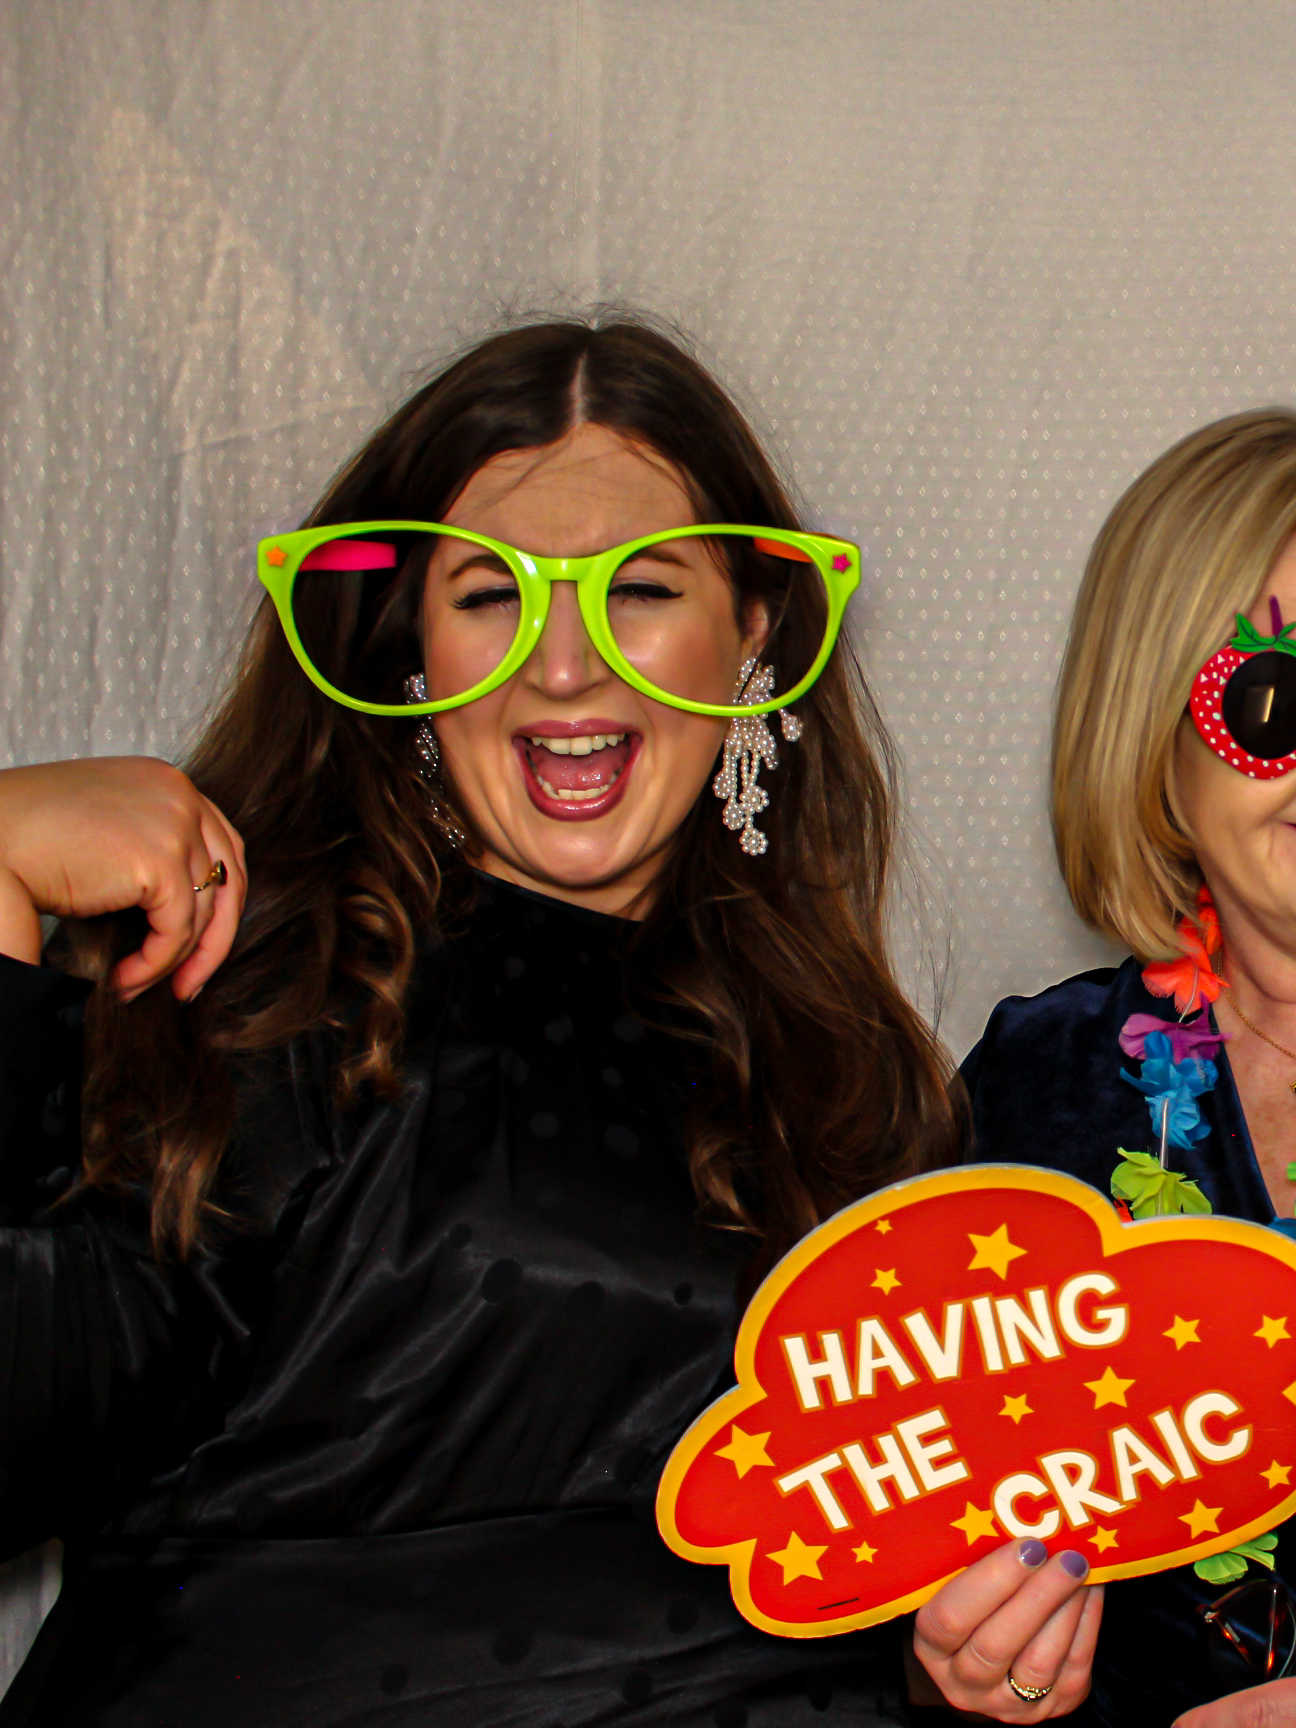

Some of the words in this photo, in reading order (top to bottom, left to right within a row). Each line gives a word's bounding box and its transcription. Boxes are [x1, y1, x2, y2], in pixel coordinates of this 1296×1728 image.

[782, 1272, 1128, 1410] HAVING
[776, 1408, 970, 1530] THE
[992, 1391, 1251, 1540] CRAIC
